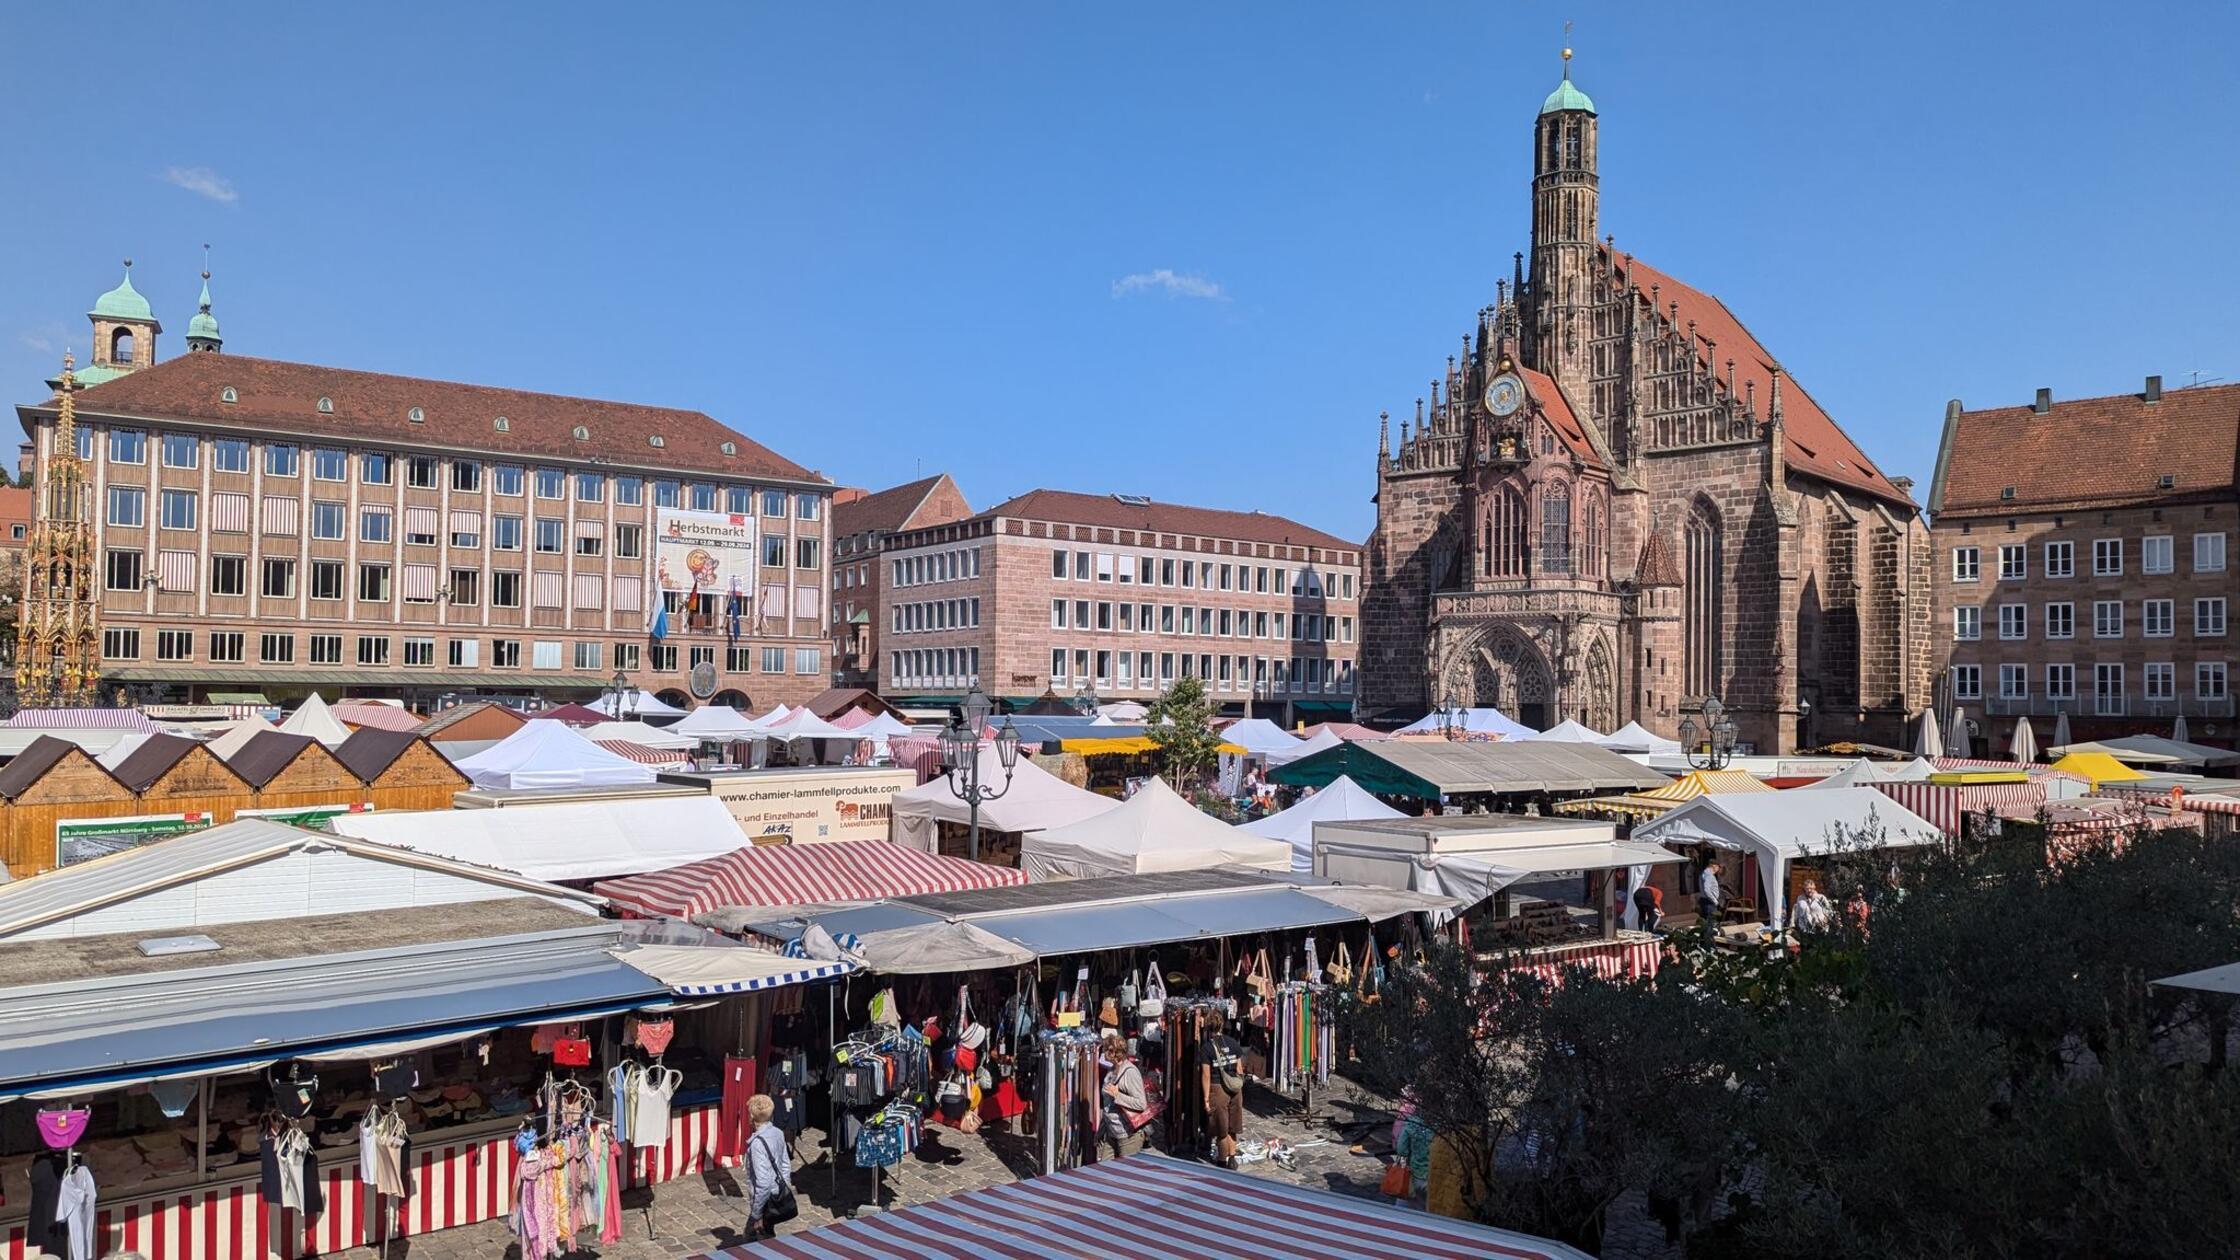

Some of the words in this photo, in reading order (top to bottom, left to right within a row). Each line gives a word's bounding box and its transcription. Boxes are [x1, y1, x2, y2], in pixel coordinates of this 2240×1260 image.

[670, 519, 745, 537] Herbstmarkt
[660, 536, 699, 545] HAUPTMARKT
[719, 785, 901, 802] www.chamier-lammfellprodukte.com
[744, 813, 761, 822] und
[763, 810, 819, 821] Einzelhandel
